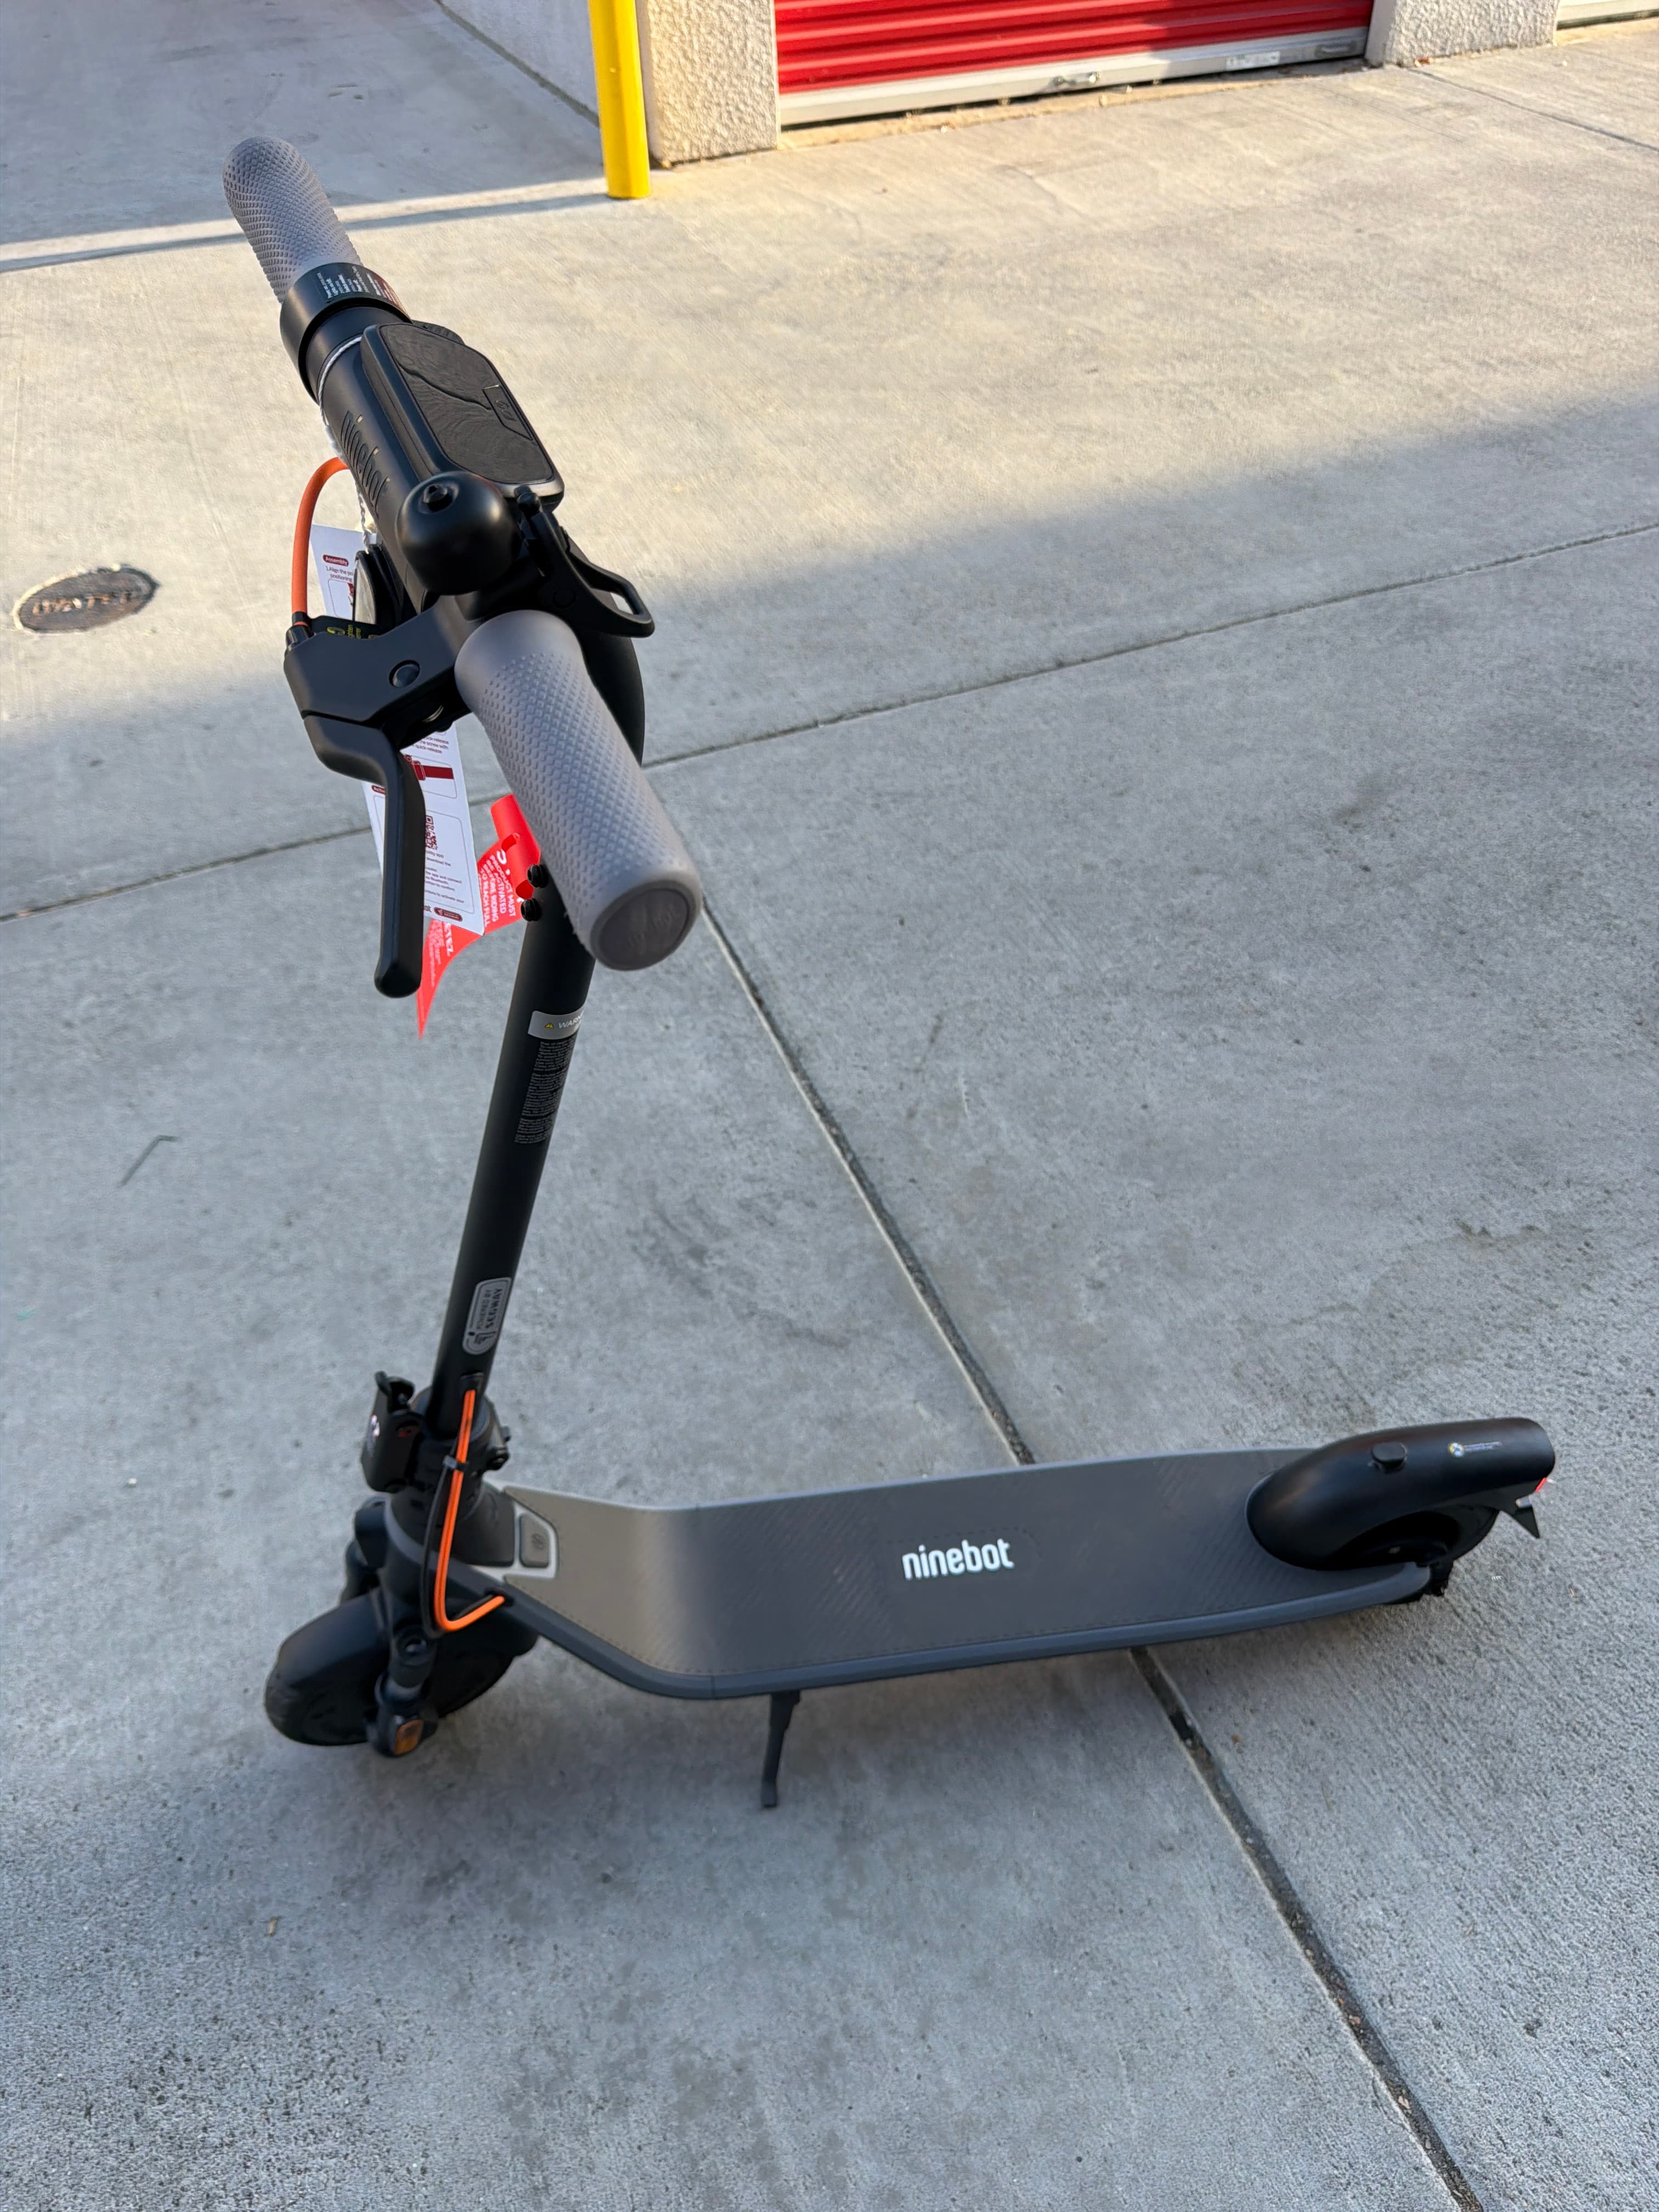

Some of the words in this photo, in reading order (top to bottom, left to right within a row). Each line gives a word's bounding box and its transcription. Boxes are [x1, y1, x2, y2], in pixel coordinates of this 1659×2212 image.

[341, 410, 391, 518] ninebot
[489, 855, 513, 893] PRODUCT
[508, 894, 516, 917] MUST
[494, 872, 507, 914] ACTIVATED
[901, 1538, 1015, 1581] ninebot
